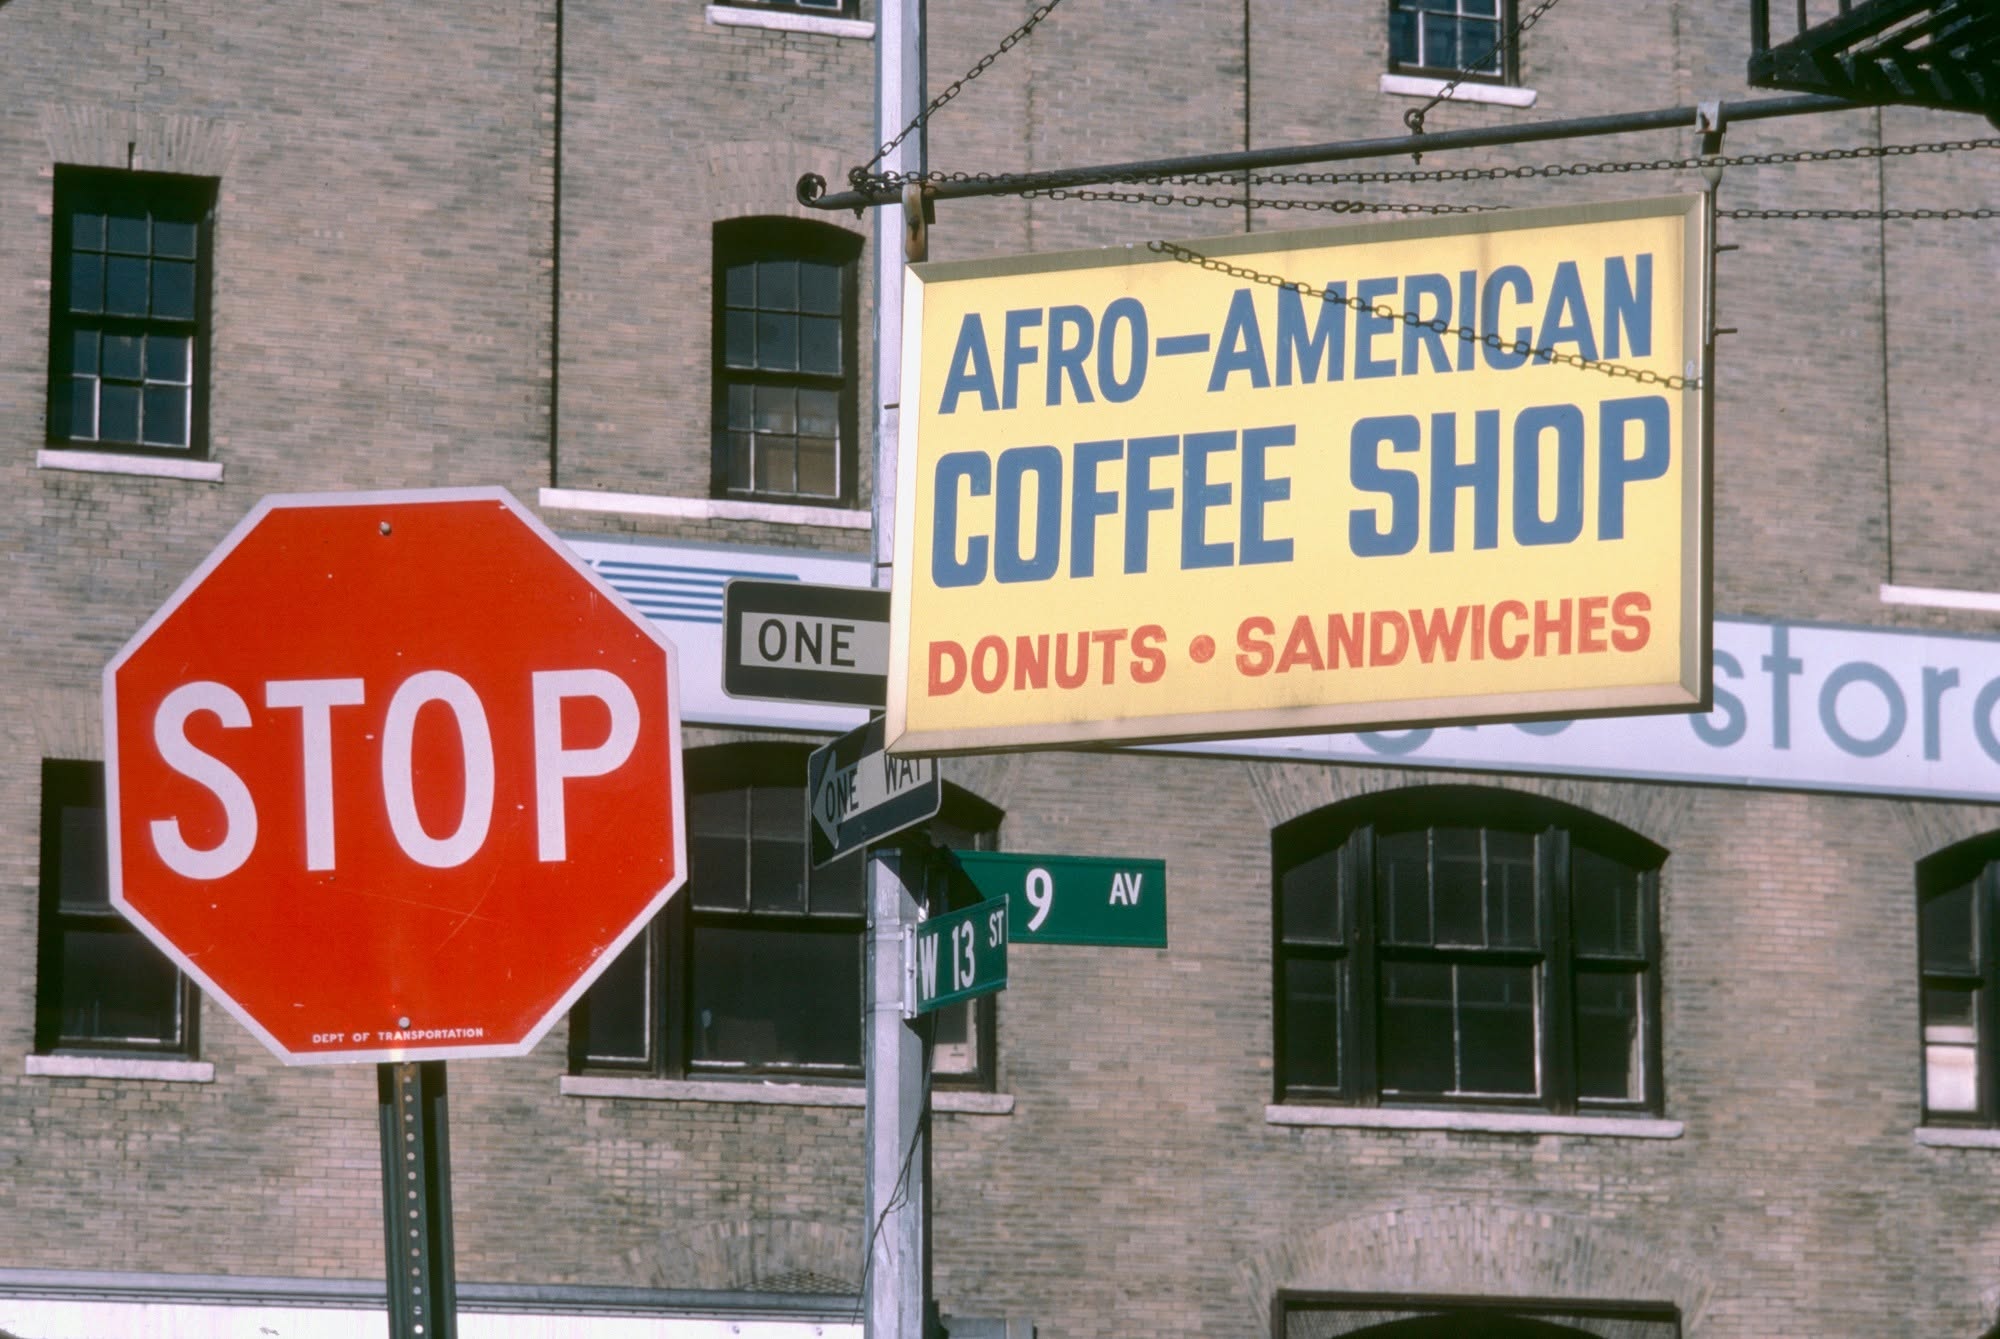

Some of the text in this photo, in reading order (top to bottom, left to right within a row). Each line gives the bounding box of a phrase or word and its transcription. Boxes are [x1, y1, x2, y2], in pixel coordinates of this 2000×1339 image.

[931, 395, 1671, 589] COFFEE SHOP
[758, 618, 856, 667] ONE
[928, 591, 1652, 697] DONUTS SANDWICHES
[1688, 625, 2000, 762] stor
[150, 668, 641, 880] STOP
[825, 768, 859, 823] ONE
[1025, 868, 1142, 932] 9 AV
[919, 910, 1005, 1001] W 13 ST
[312, 1027, 484, 1044] DEPT OF TRANSPORTATION
